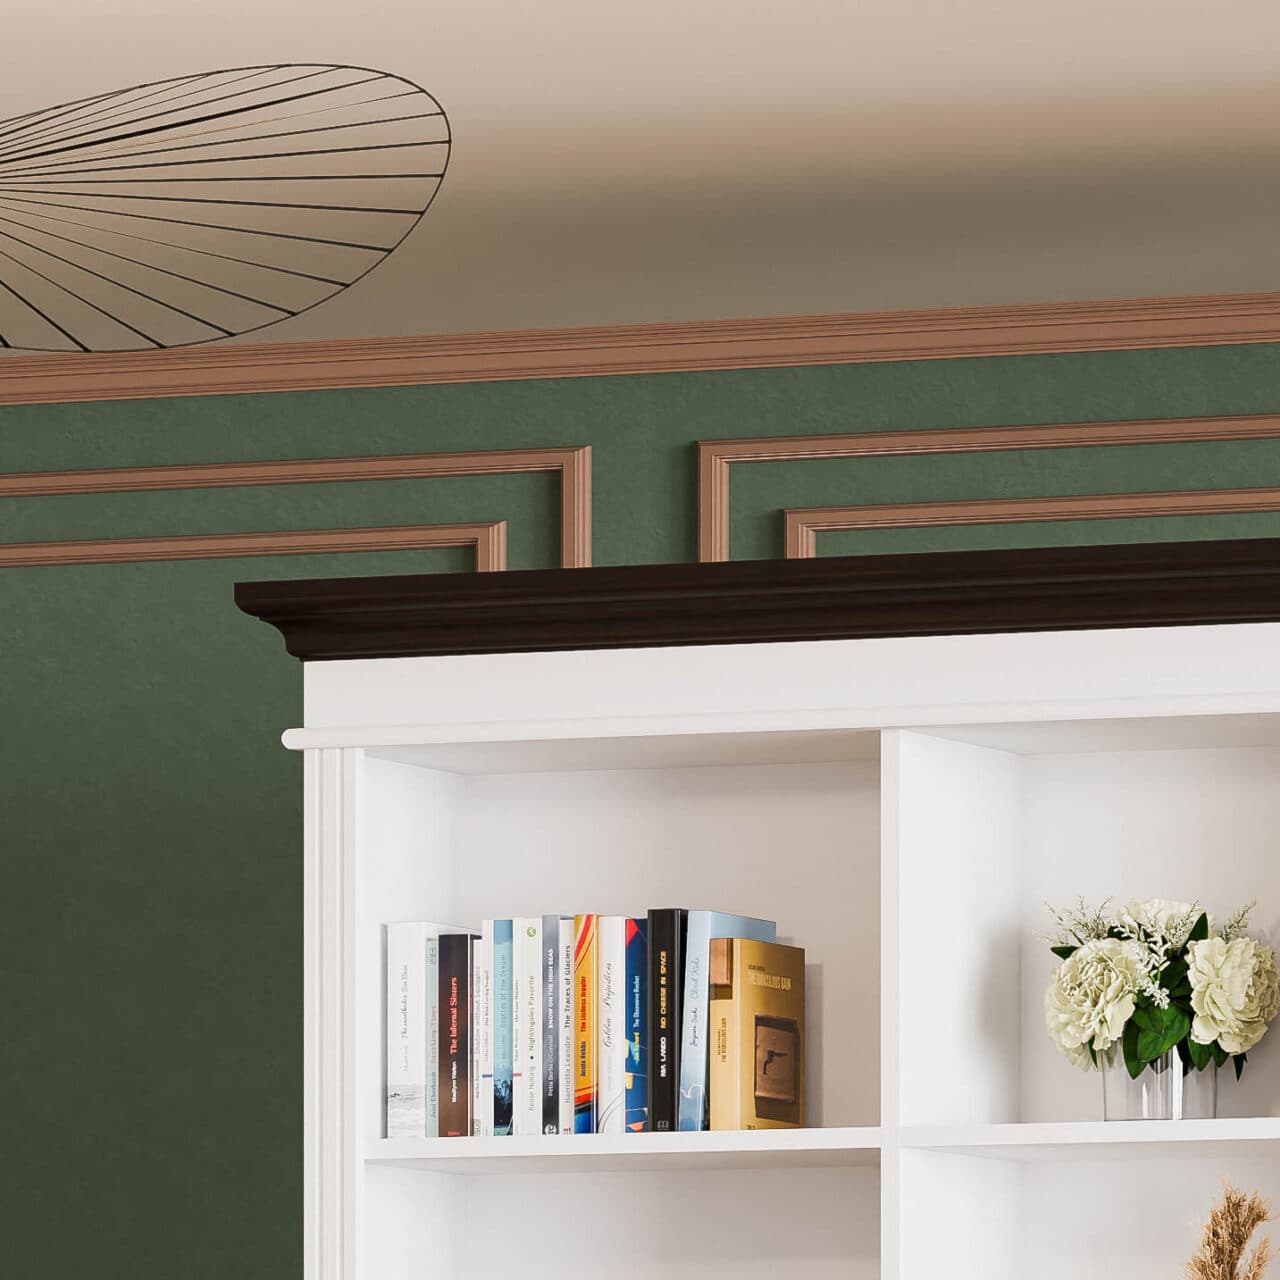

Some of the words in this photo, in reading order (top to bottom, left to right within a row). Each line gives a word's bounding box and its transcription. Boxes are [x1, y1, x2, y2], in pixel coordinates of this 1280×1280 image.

[564, 978, 571, 986] of
[450, 976, 458, 1006] Sisters
[547, 996, 554, 1008] ON
[450, 1008, 458, 1036] Infernal
[450, 1040, 458, 1055] The
